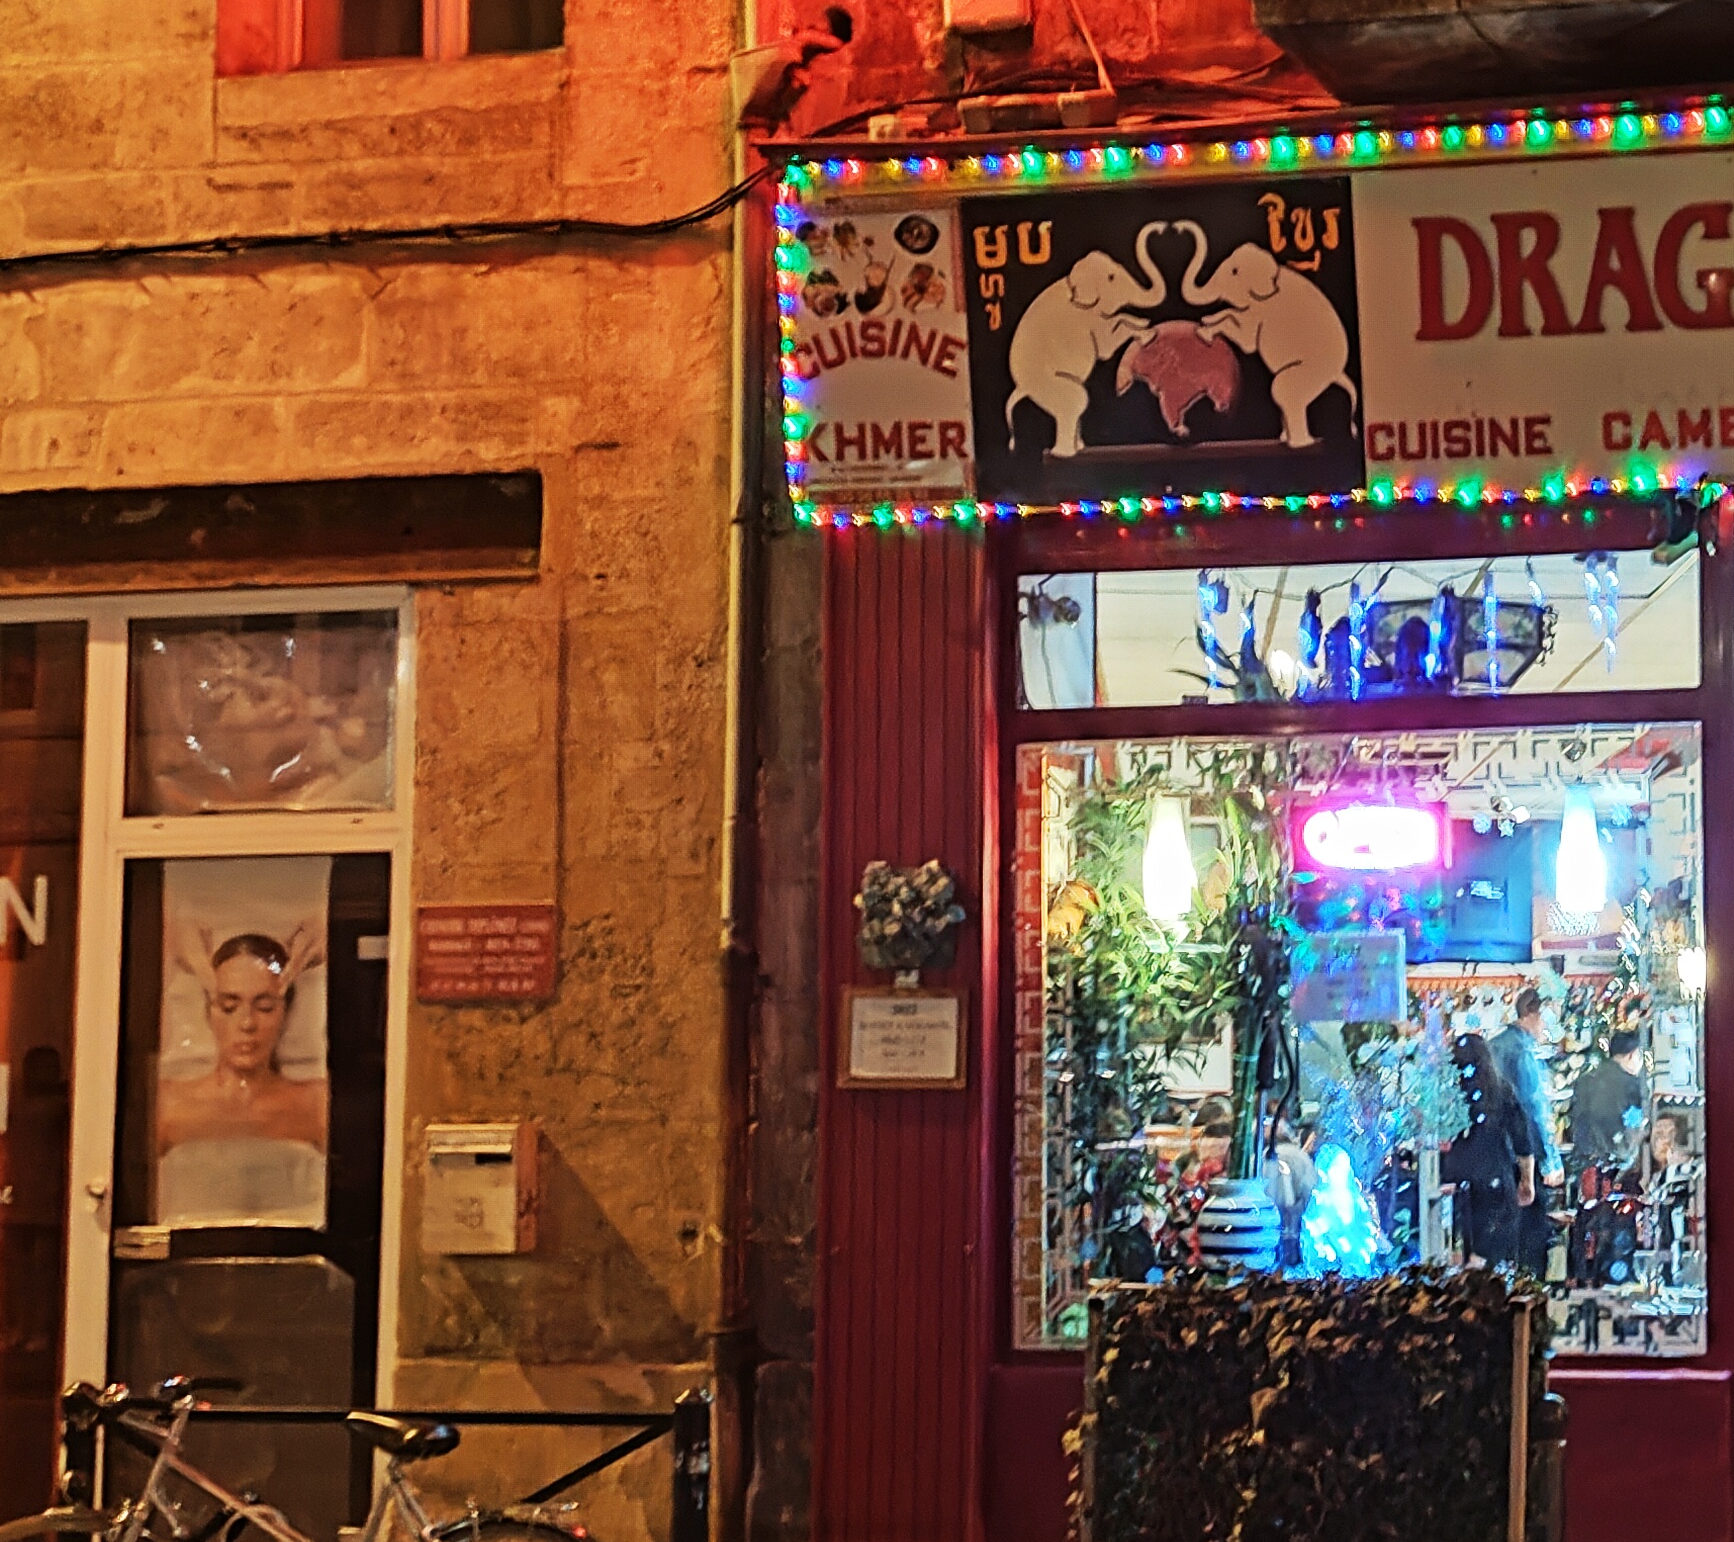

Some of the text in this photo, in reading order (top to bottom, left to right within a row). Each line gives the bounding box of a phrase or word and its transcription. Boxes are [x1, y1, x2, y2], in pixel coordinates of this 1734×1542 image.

[793, 318, 966, 382] CUISINE
[808, 419, 968, 463] KHMER
[1367, 413, 1554, 461] CUISINE
